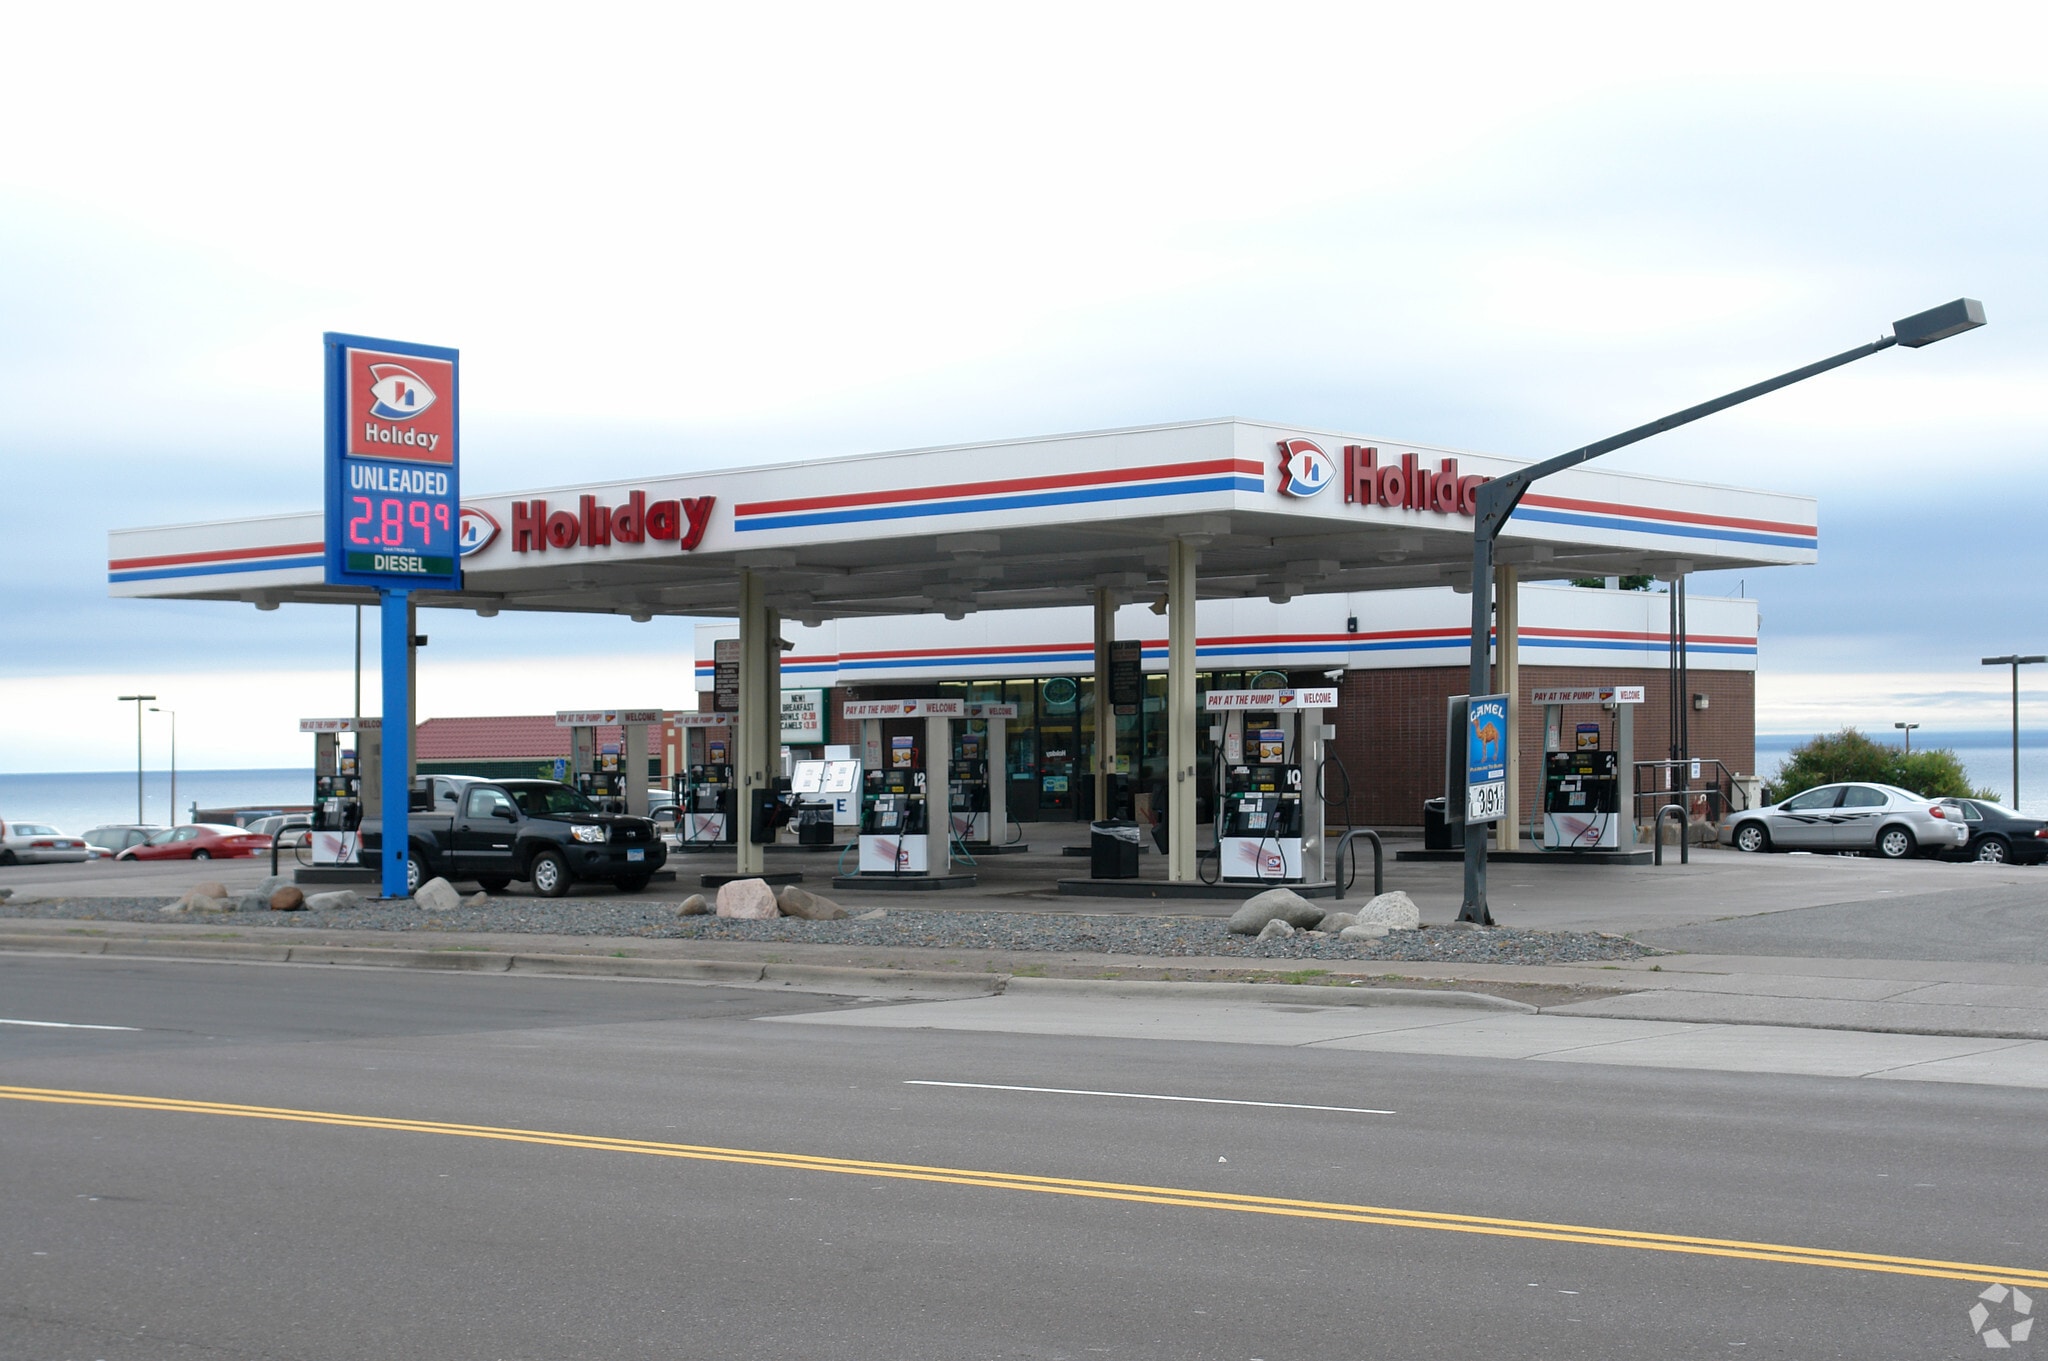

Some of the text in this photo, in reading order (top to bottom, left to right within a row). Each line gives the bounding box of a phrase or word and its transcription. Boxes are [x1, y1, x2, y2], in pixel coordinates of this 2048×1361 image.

[365, 422, 439, 451] Holiday
[351, 465, 448, 496] UNLEADED
[1343, 444, 1490, 516] Holida
[511, 489, 717, 553] Holiday
[374, 554, 427, 573] DIESEL
[1208, 694, 1275, 705] PAY AT THE PUMP!
[1303, 692, 1332, 704] WELCOME
[1534, 691, 1595, 701] PAY AT THE PUMP!
[1620, 690, 1640, 700] WELCOME
[782, 703, 814, 712] BREAKFAST
[845, 704, 900, 715] PAY AT THE PUMP!
[926, 703, 957, 713] WELCOME
[989, 707, 1013, 715] WELCOME
[1470, 703, 1505, 722] CAMEL
[557, 714, 567, 723] PAY
[567, 714, 575, 722] AT
[575, 714, 585, 722] THE
[625, 712, 656, 722] WELCOME
[780, 712, 799, 721] BOWLS
[358, 720, 382, 728] WELCO
[780, 721, 803, 729] CAMELS
[1605, 754, 1615, 768] 2
[914, 772, 926, 787] 12
[1287, 769, 1301, 784] 10
[1478, 786, 1499, 814] 391
